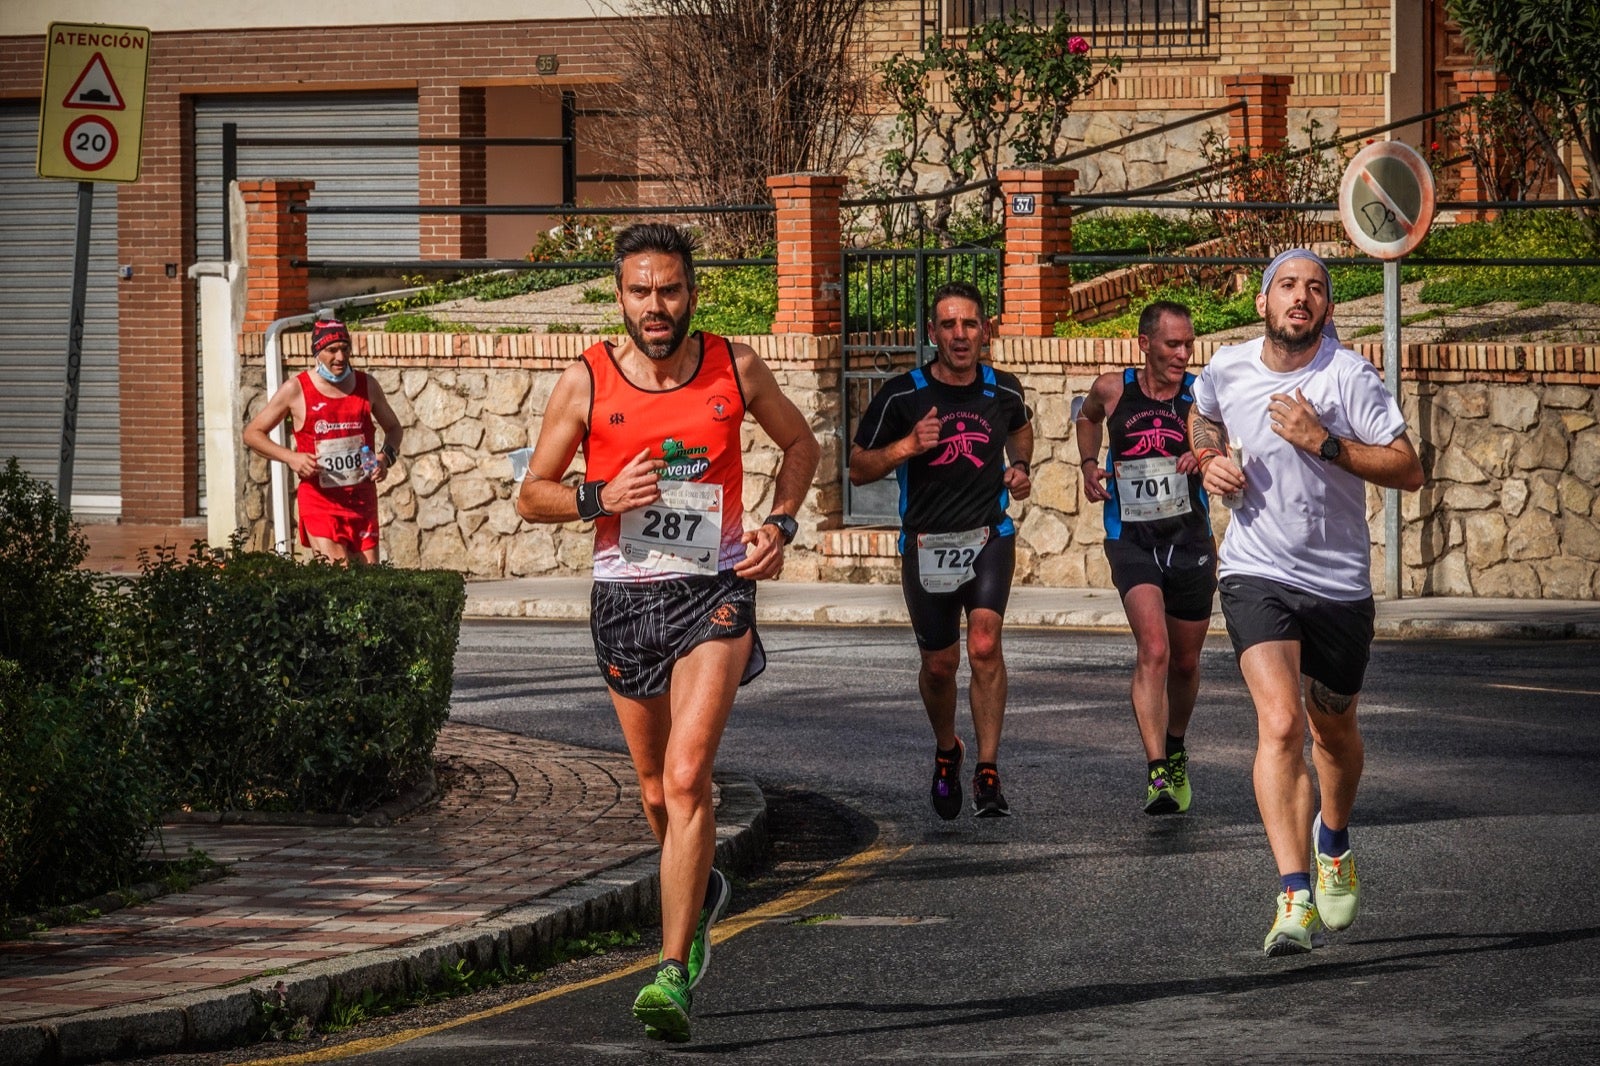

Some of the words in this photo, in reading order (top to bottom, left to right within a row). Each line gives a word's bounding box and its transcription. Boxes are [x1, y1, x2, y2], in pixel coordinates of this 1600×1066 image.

[54, 31, 144, 49] ATENCIÓN
[76, 132, 106, 152] 20
[1016, 198, 1030, 211] 37
[956, 411, 979, 420] CULLAR
[675, 440, 684, 449] a
[677, 446, 708, 456] mano
[324, 453, 362, 472] 3008
[1131, 477, 1171, 499] 701
[642, 510, 702, 541] 287
[934, 548, 975, 568] 722
